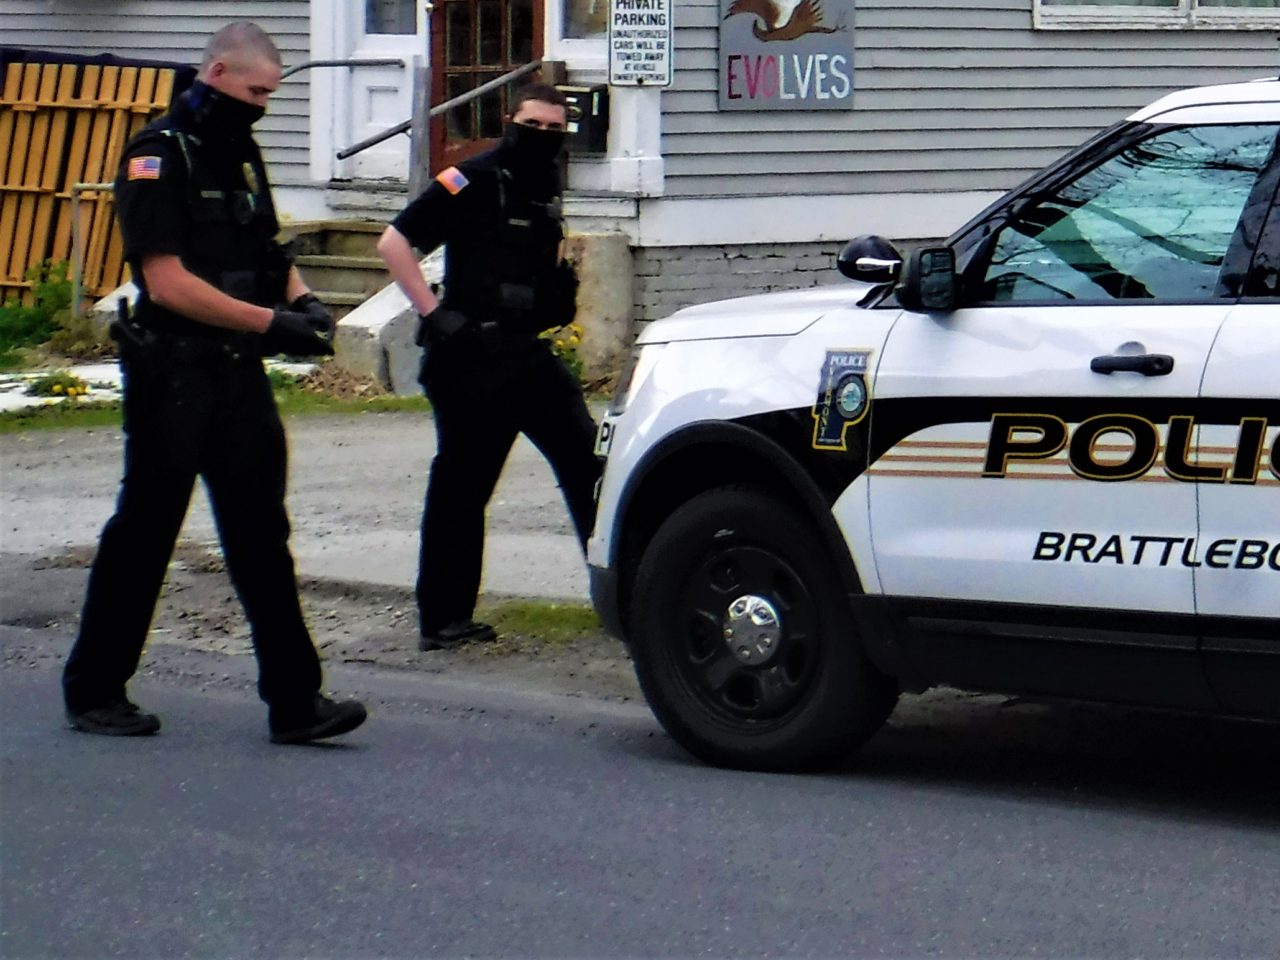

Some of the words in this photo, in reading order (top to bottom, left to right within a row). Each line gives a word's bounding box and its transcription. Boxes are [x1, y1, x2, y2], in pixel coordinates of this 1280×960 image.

[614, 13, 666, 26] PARKING
[613, 41, 634, 50] CARS
[636, 41, 653, 50] WILL
[656, 41, 665, 50] BE
[616, 52, 642, 62] TOWED
[644, 52, 664, 61] AWAY
[727, 55, 850, 100] EVOLVES
[829, 355, 866, 367] POLICE
